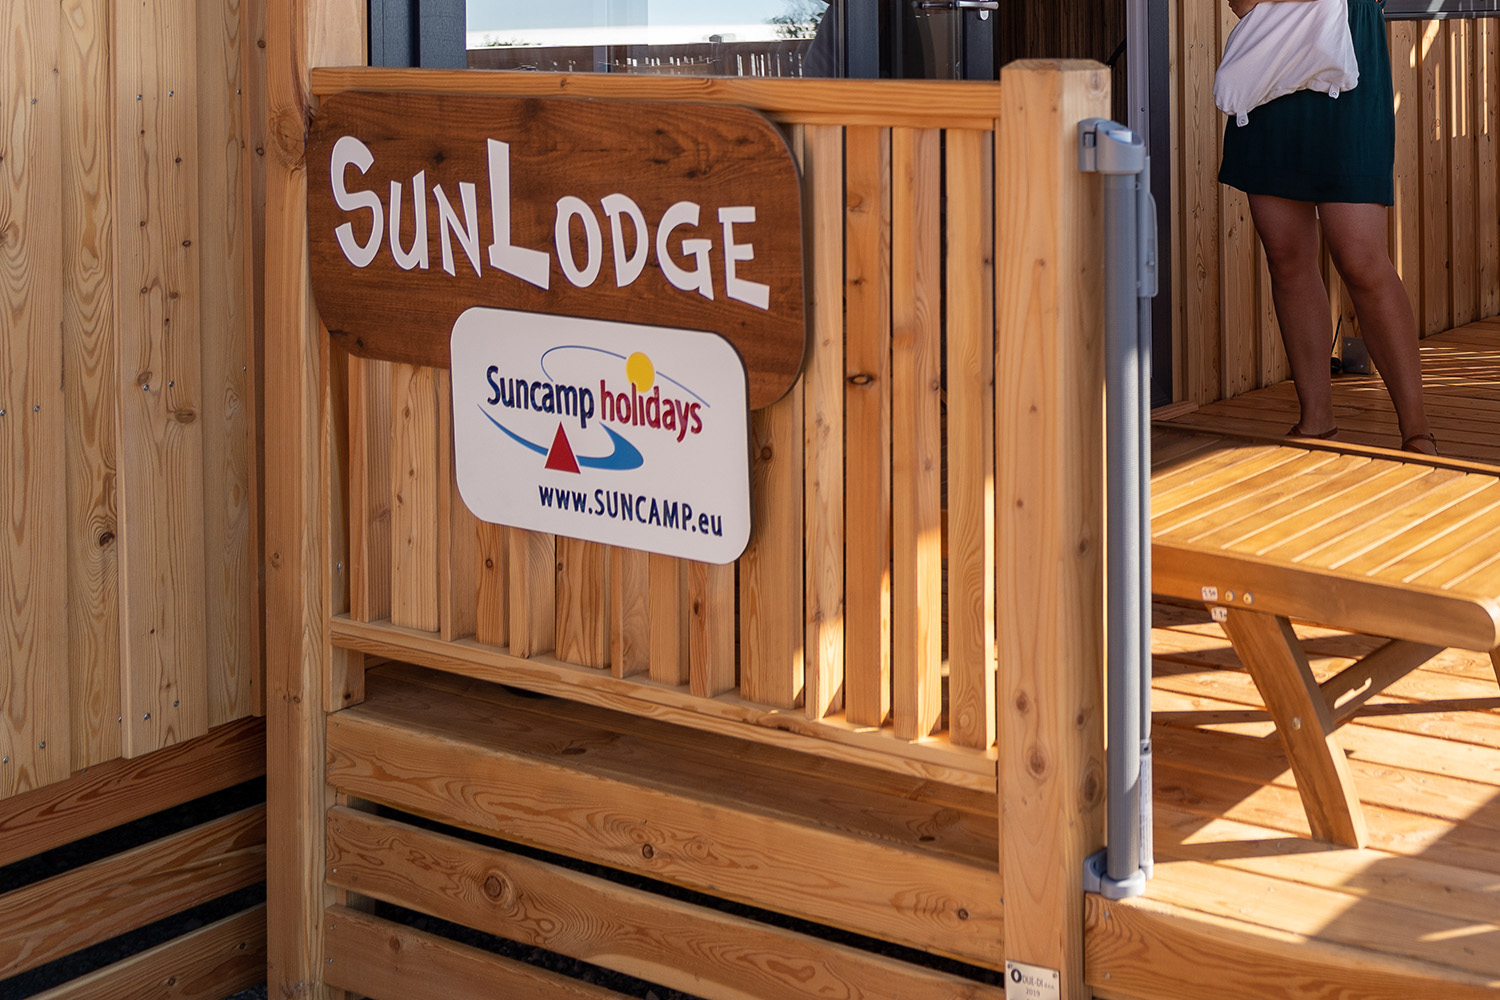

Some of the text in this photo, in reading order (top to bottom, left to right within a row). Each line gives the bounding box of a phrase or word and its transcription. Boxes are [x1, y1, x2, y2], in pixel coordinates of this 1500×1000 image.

[485, 364, 703, 443] Suncamp holidays
[538, 484, 723, 537] www.SUNCAMP.eu
